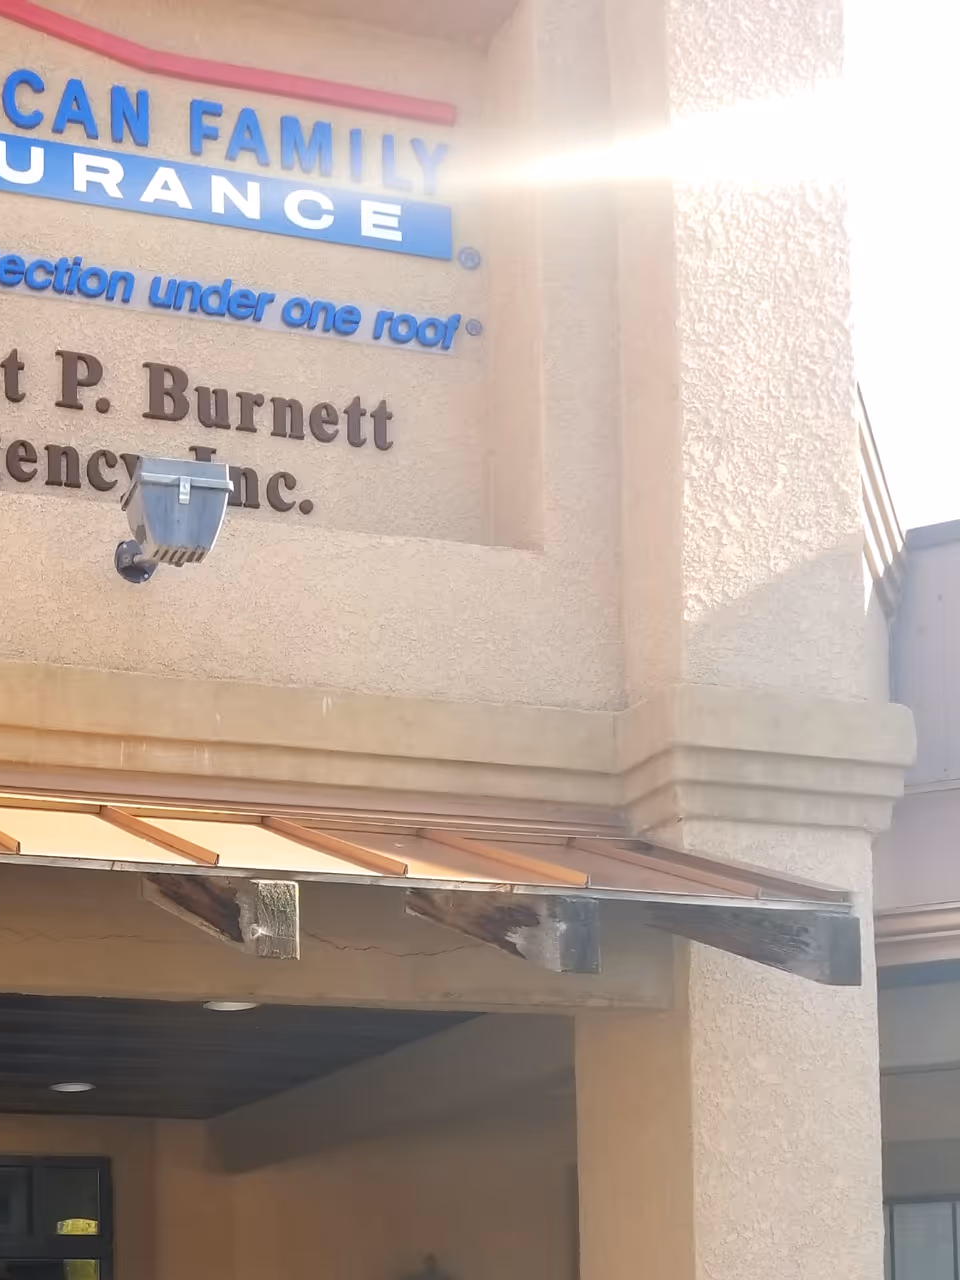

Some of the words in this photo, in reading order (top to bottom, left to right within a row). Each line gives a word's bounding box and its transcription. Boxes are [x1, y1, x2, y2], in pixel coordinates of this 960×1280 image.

[189, 98, 449, 195] FAMILY
[148, 276, 276, 322] under
[282, 296, 362, 336] one
[373, 309, 461, 350] roof
[55, 349, 111, 414] P.
[142, 361, 394, 451] Burnett
[188, 445, 314, 515] nc.
